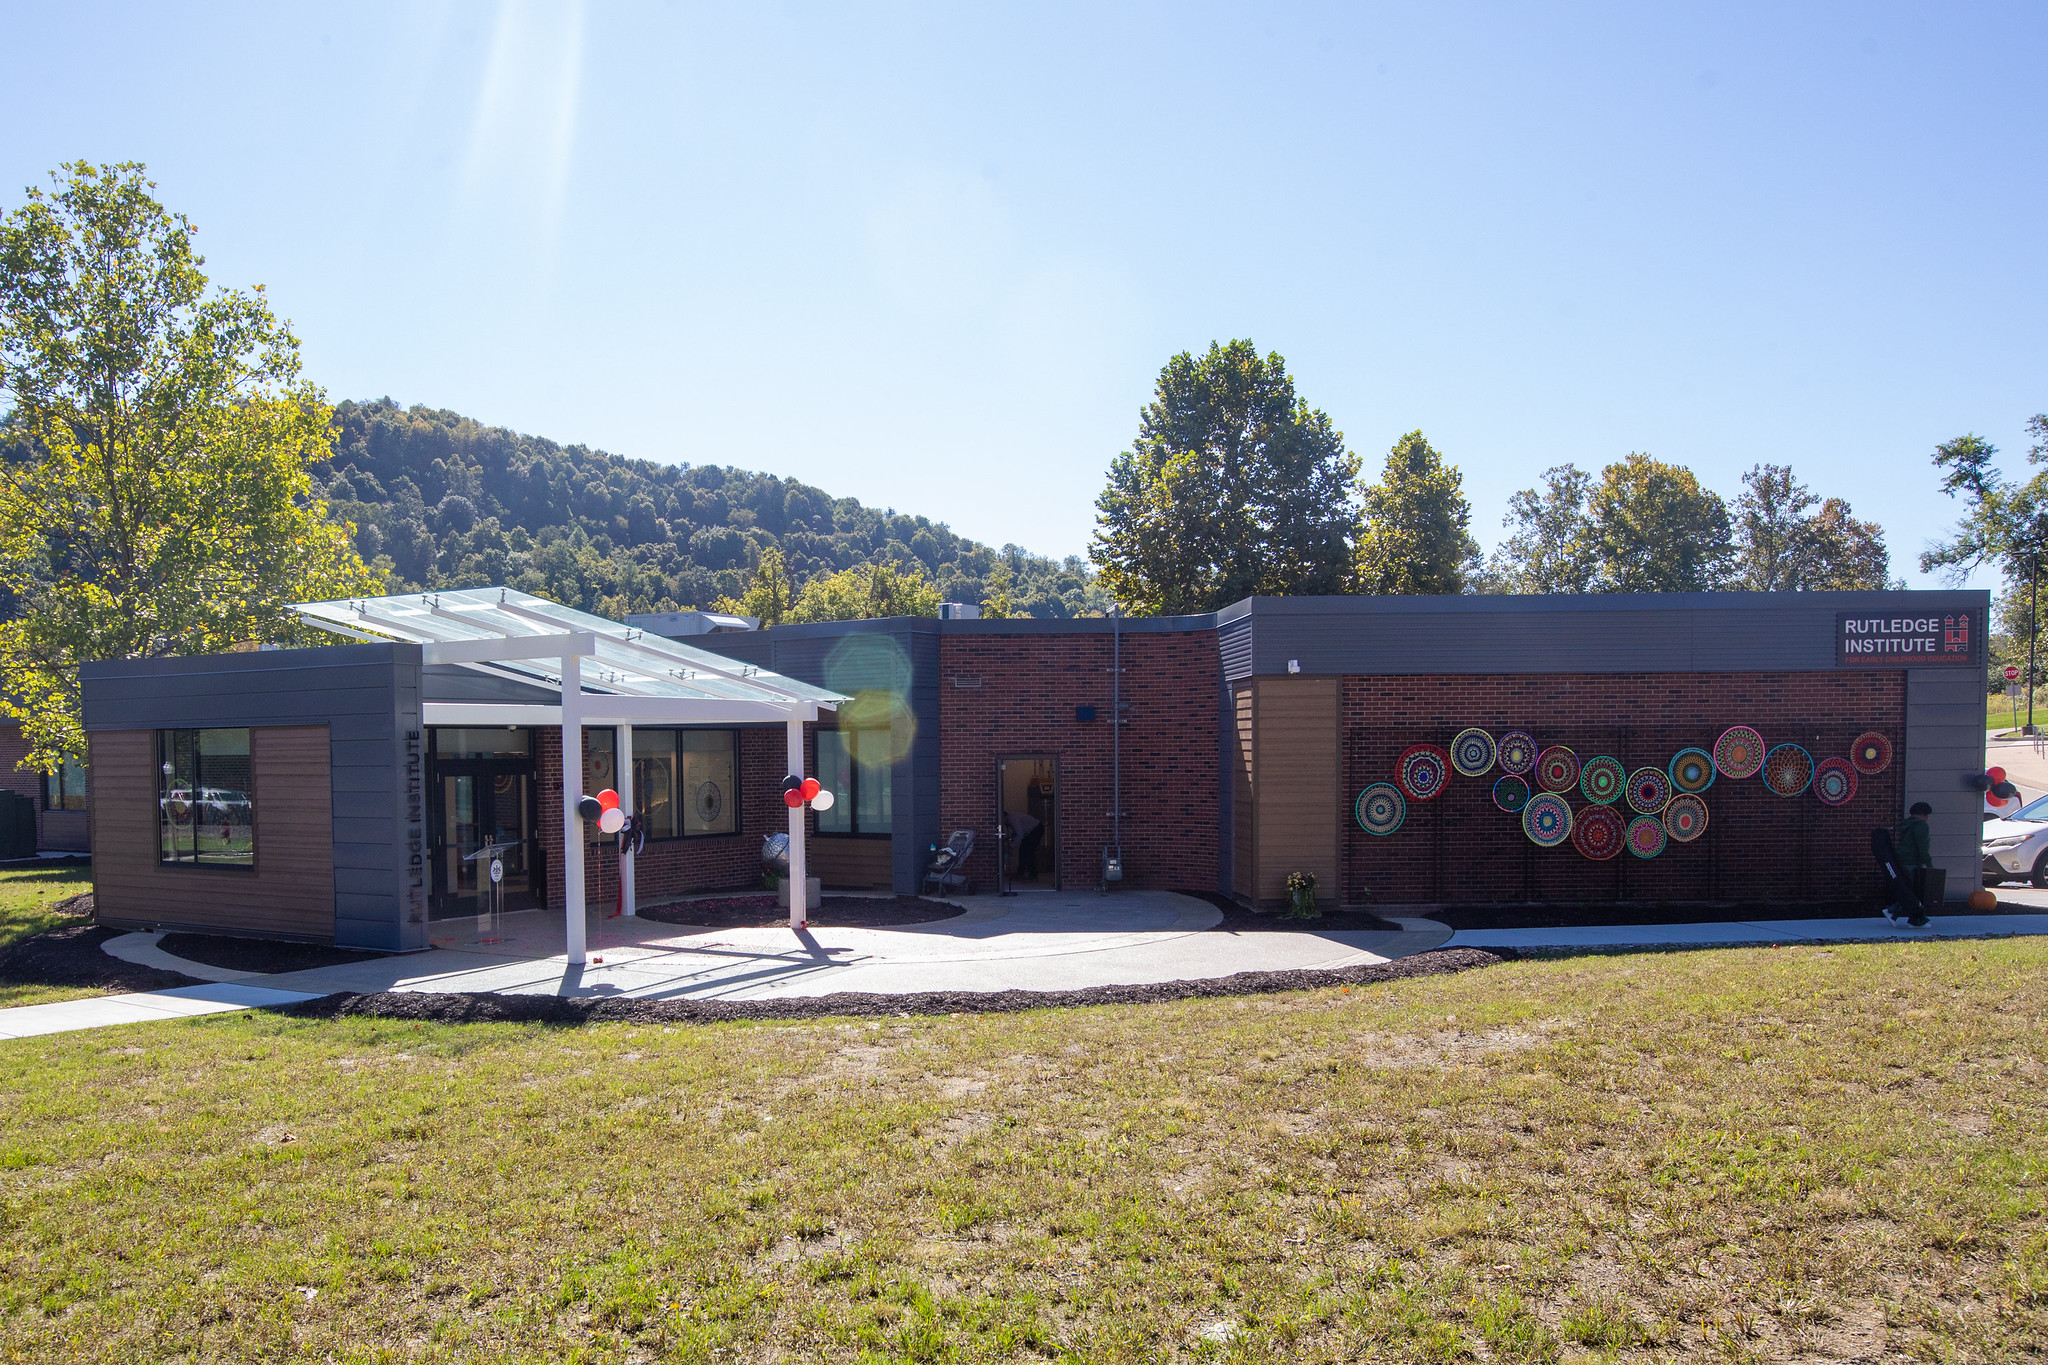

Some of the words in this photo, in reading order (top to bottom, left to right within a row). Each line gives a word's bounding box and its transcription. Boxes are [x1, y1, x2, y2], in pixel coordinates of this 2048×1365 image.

[1845, 618, 1939, 634] RUTLEDGE
[1845, 638, 1936, 653] INSTITUTE
[1885, 655, 1926, 663] CHILDHOOD
[408, 731, 420, 822] INSTITUTE
[409, 828, 422, 924] RUTLEDGE
